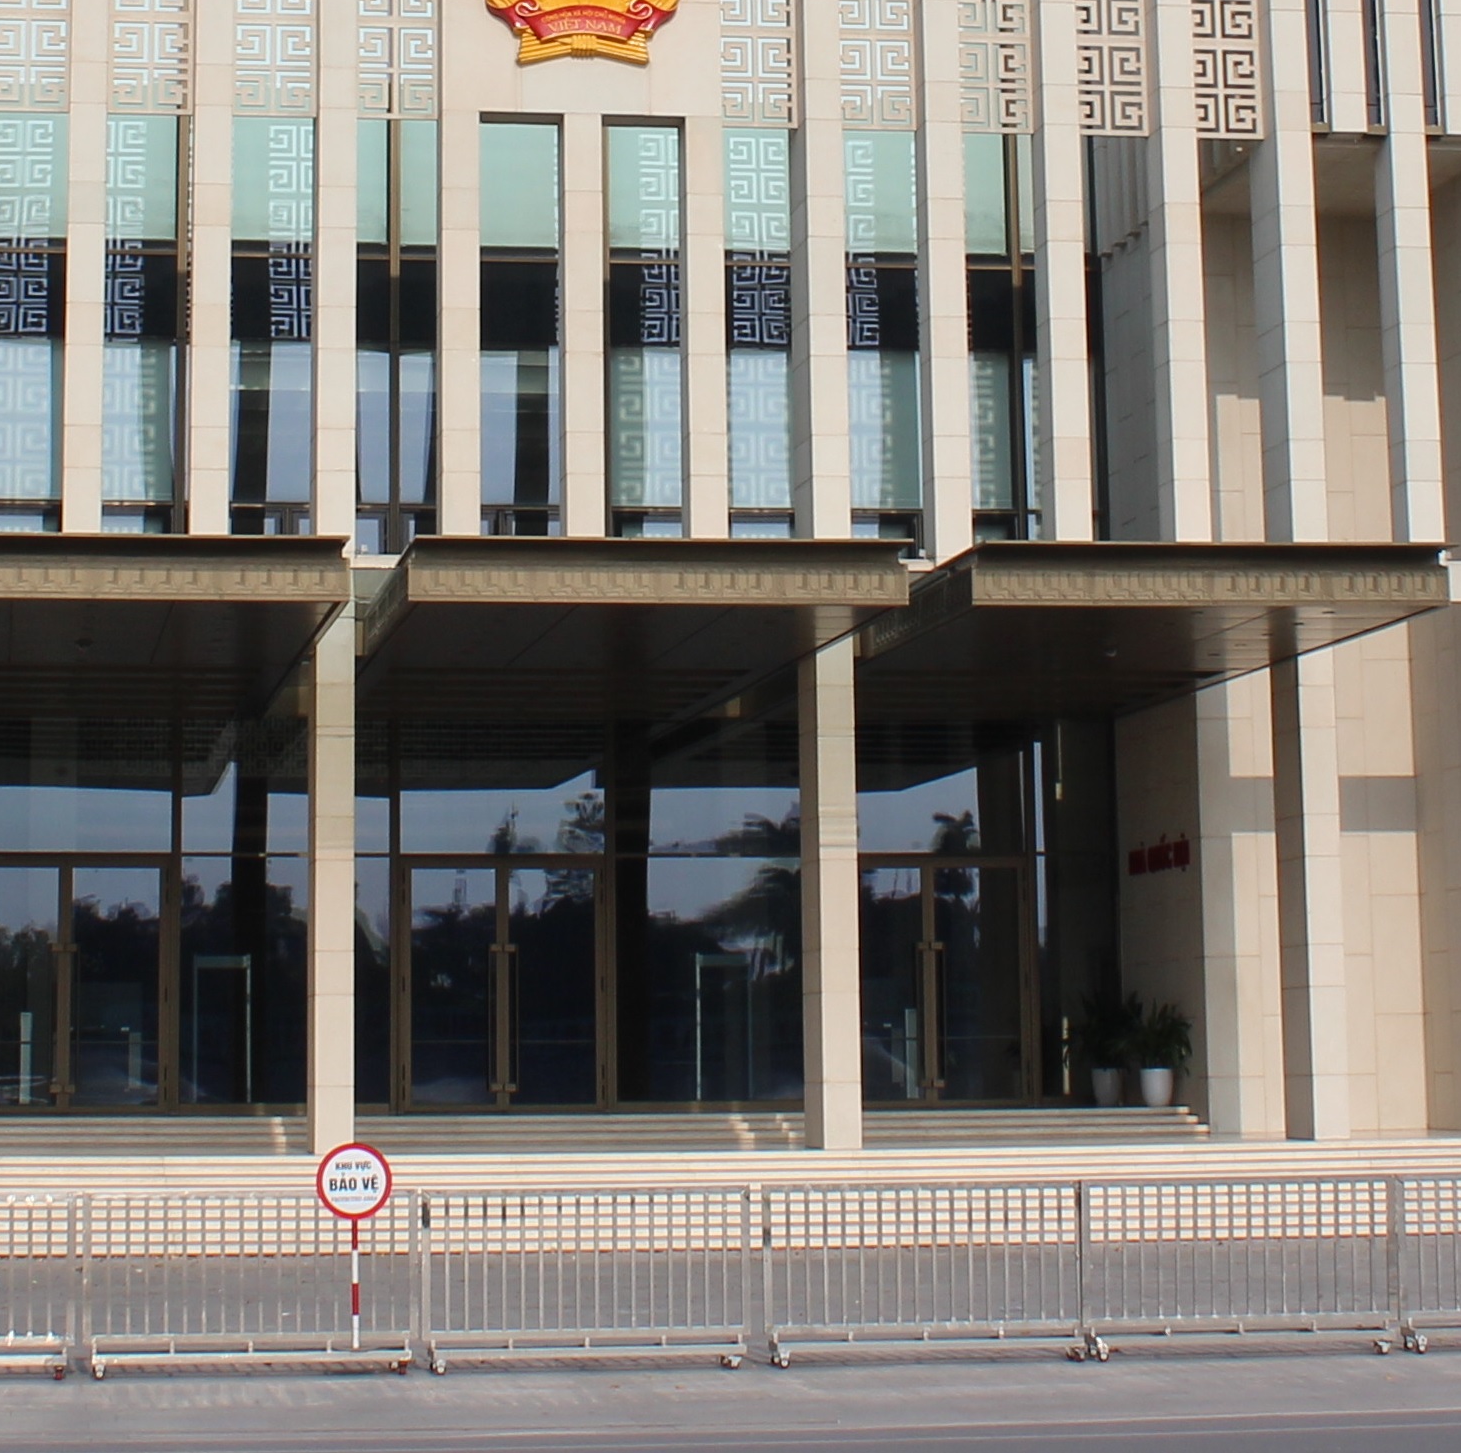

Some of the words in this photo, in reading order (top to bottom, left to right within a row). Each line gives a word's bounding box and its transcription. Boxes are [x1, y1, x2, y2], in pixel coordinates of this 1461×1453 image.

[585, 19, 622, 35] NAM
[329, 1172, 357, 1191] BẢO
[362, 1173, 379, 1193] VỆ
